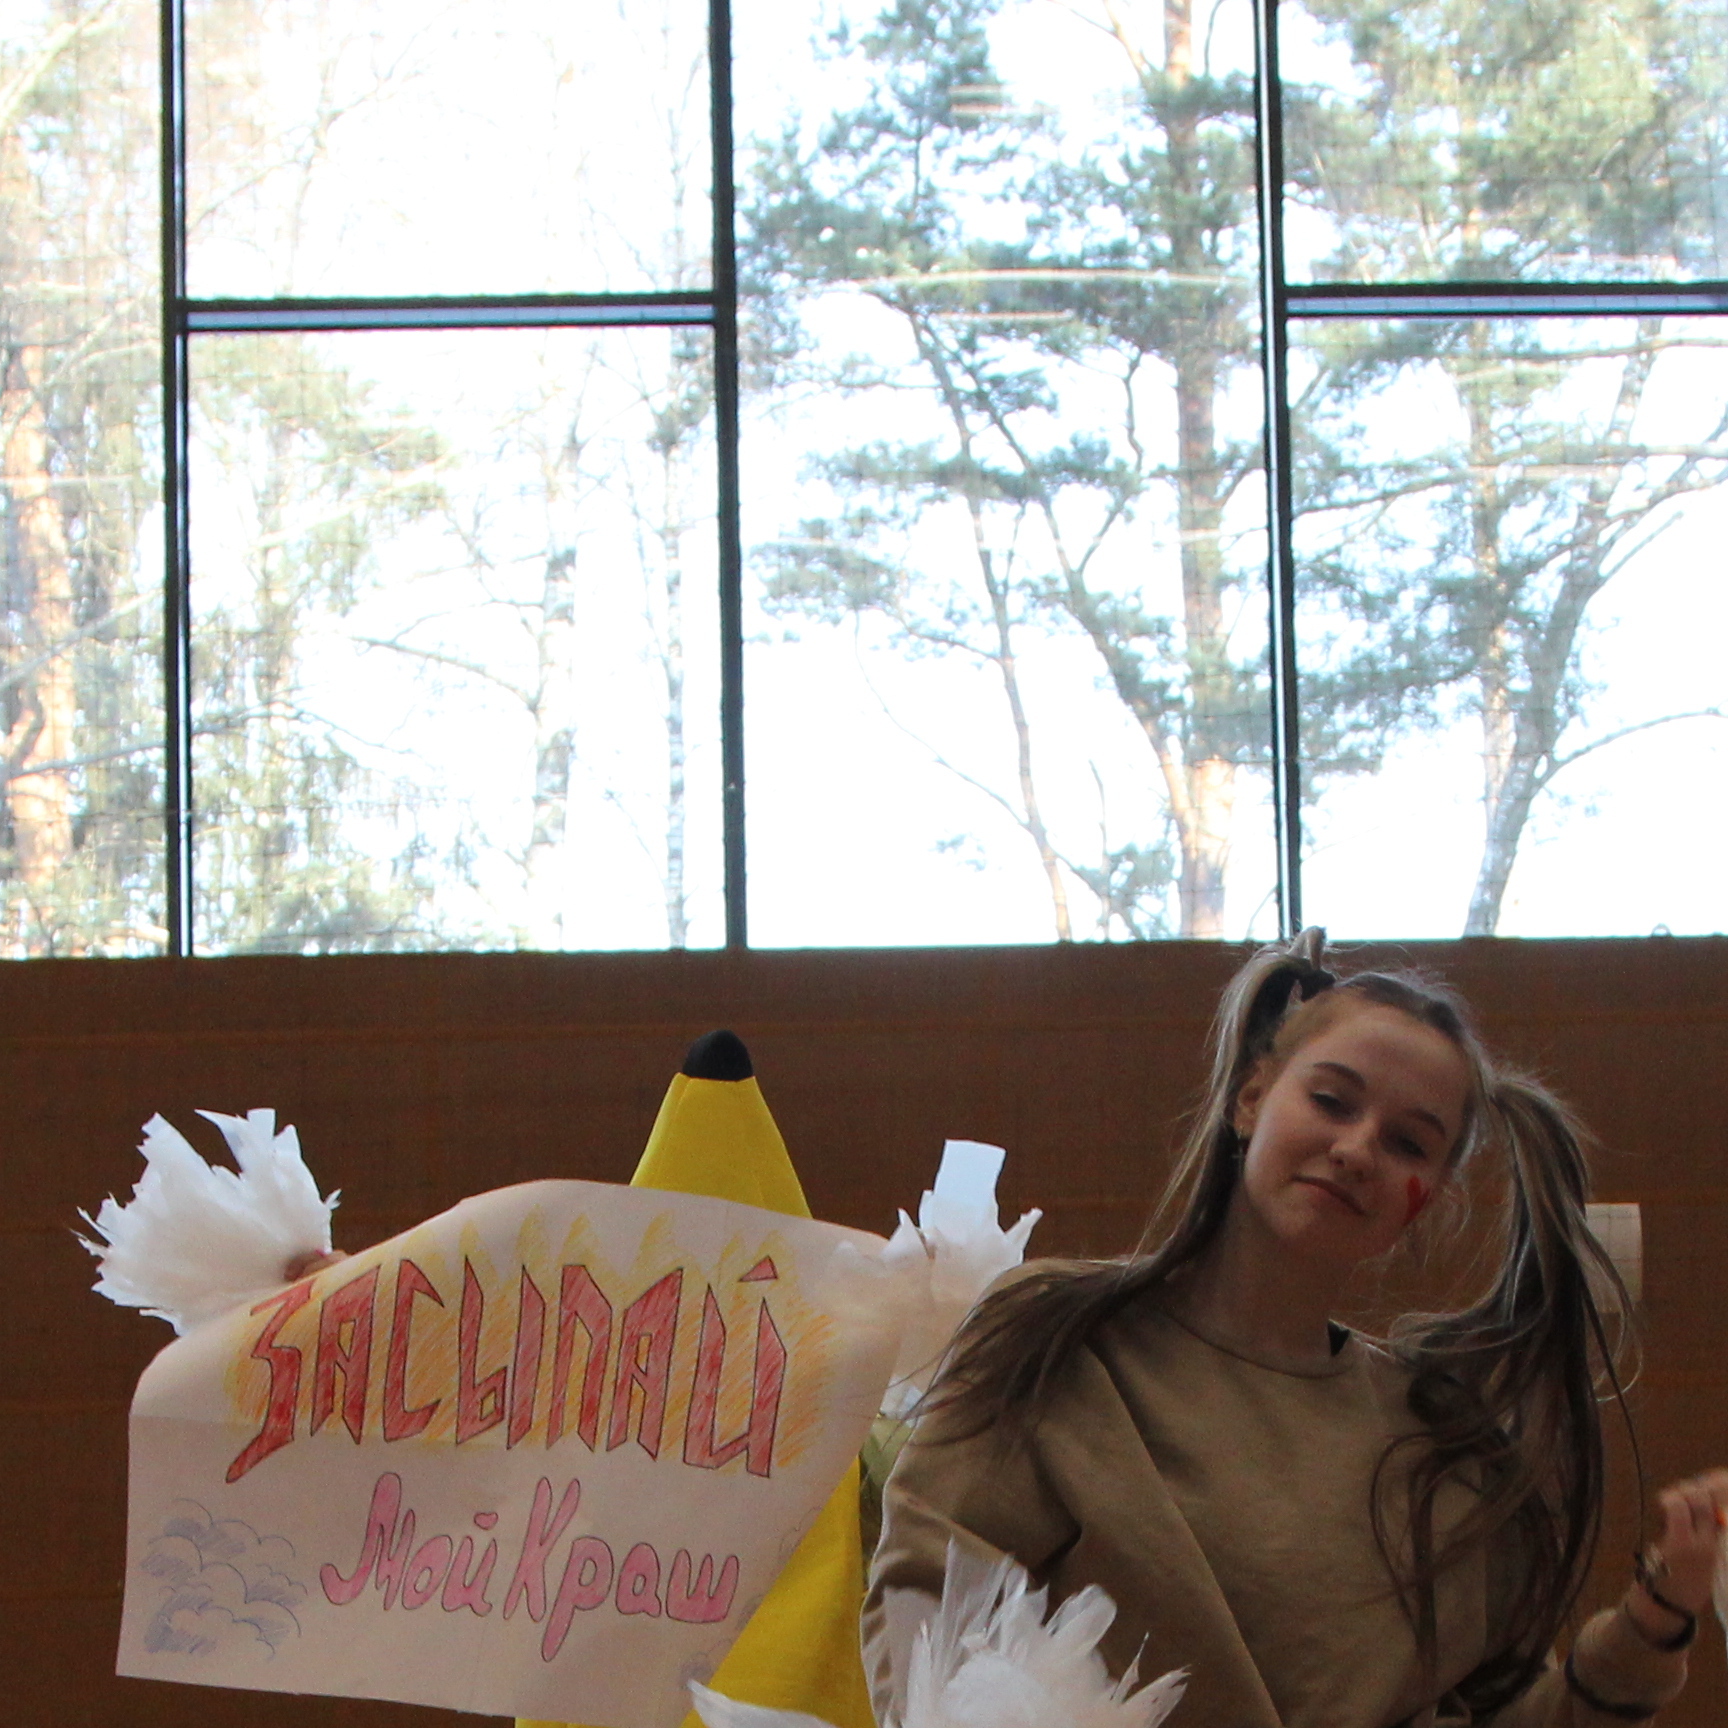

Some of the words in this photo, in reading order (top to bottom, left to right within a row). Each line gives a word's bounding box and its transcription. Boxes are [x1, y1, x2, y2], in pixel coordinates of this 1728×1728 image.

[225, 1254, 788, 1484] ЗАСЫПАЙ
[319, 1471, 499, 1619] Мой
[503, 1477, 740, 1663] Краш
